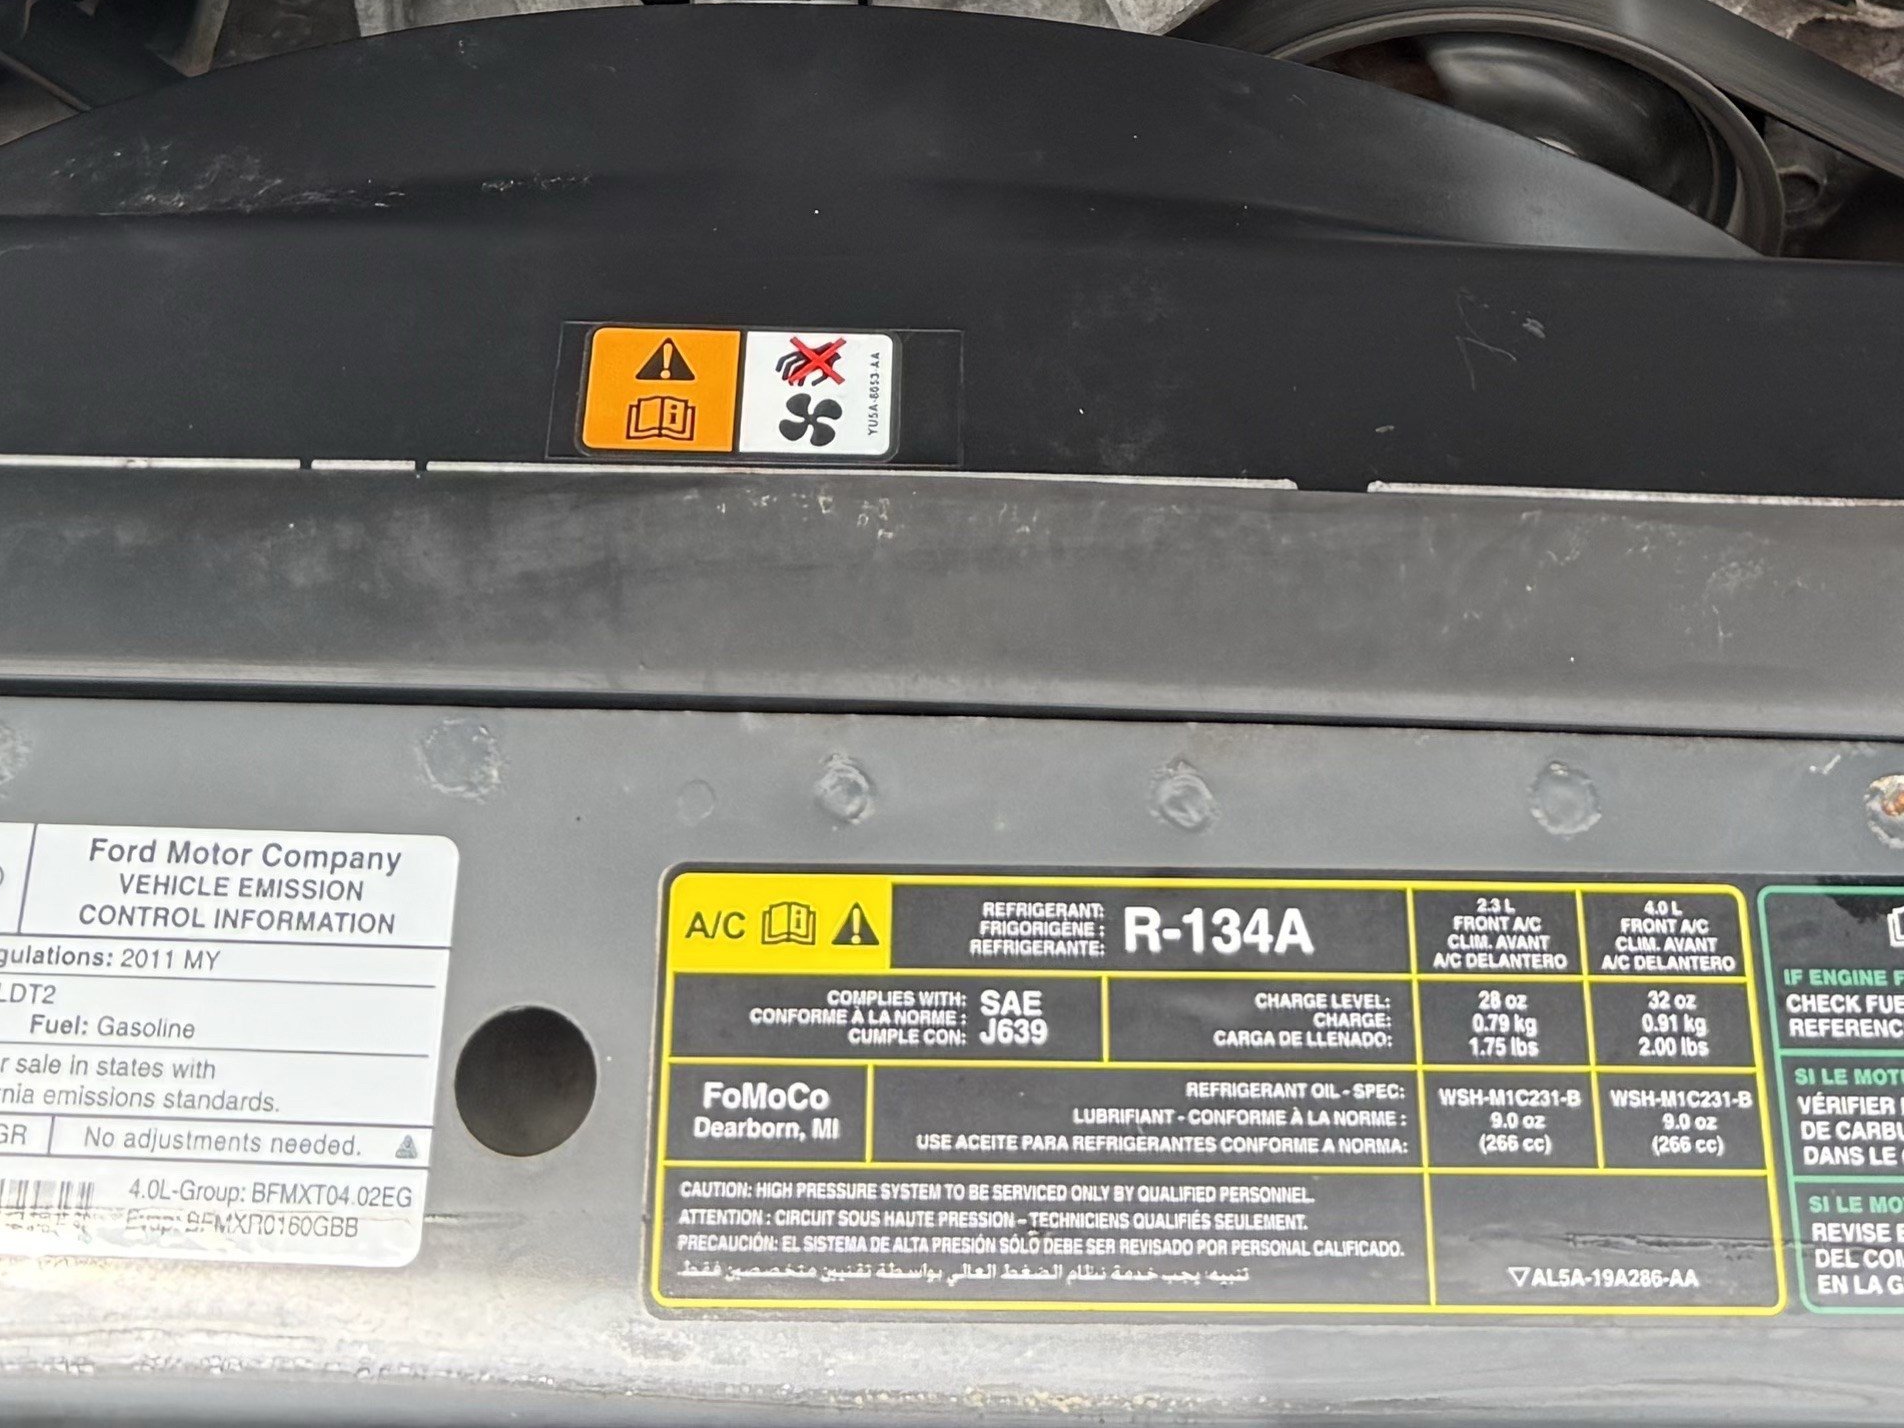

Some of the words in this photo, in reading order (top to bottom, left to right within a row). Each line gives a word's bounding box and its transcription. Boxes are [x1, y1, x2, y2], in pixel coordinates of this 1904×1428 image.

[88, 837, 157, 863] Ford
[166, 839, 253, 867] Motor
[261, 842, 402, 876] Company
[119, 872, 230, 897] VEHICLE
[237, 876, 364, 901] EMISSION
[981, 901, 1104, 919] REFRIGERANT:
[1476, 897, 1501, 914] 2.3
[1503, 897, 1516, 914] L
[1643, 899, 1669, 916] 4.0
[1670, 900, 1683, 916] L
[78, 903, 205, 928] CONTROL
[213, 907, 395, 934] INFORMATION
[684, 910, 745, 939] A/C
[1452, 915, 1510, 932] FRONT
[1511, 915, 1542, 932] A/C
[1124, 906, 1315, 955] R-134A
[968, 938, 1105, 957] REFRIGERANTE:
[1446, 933, 1493, 950] CLIM.
[1494, 934, 1550, 951] AVANT
[119, 947, 173, 969] 2011
[183, 948, 221, 971] MY
[1432, 951, 1462, 969] A/C
[1464, 952, 1568, 970] DELANTERO
[1783, 968, 1803, 985] IF
[1808, 968, 1888, 986] ENGINE
[826, 989, 915, 1007] COMPLIES
[917, 990, 966, 1007] WITH:
[979, 988, 1042, 1016] SAE
[1254, 991, 1328, 1009] CHARGE
[1330, 993, 1390, 1010] LEVEL:
[1477, 989, 1502, 1010] 28
[1504, 993, 1528, 1011] oz
[1647, 989, 1671, 1010] 32
[1673, 993, 1697, 1010] oz
[29, 1013, 88, 1035] Fuel:
[96, 1014, 195, 1039] Gasoline
[978, 1017, 1048, 1045] J639
[1312, 1011, 1392, 1029] CHARGE:
[1471, 1012, 1510, 1033] 0.79
[1513, 1012, 1538, 1035] kg
[1641, 1012, 1678, 1033] 0.91
[1683, 1013, 1709, 1036] kg
[847, 1027, 920, 1045] CUMPLE
[922, 1027, 966, 1046] CON:
[1468, 1035, 1507, 1057] 1.75
[1509, 1035, 1539, 1057] lbs
[1637, 1036, 1677, 1057] 2.00
[1680, 1035, 1710, 1057] lbs
[14, 1052, 62, 1075] sale
[68, 1053, 88, 1076] in
[95, 1056, 164, 1078] states
[171, 1058, 216, 1080] with
[42, 1084, 155, 1108] emissions
[162, 1088, 279, 1112] standards.
[702, 1081, 830, 1111] FoMoCo
[1437, 1087, 1582, 1108] WSH-M1C231-B
[1609, 1088, 1753, 1108] WSH-M1C231-B
[692, 1115, 806, 1142] Dearborn,
[810, 1117, 840, 1139] MI
[1489, 1110, 1519, 1129] 9.0
[1521, 1114, 1546, 1130] oz
[83, 1125, 115, 1148] No
[122, 1127, 261, 1153] adjustments
[269, 1133, 361, 1156] needed.
[1478, 1132, 1519, 1155] (266
[1521, 1133, 1552, 1155] cc)
[128, 1177, 246, 1206] 4.0L-Group:
[250, 1181, 412, 1208] BFMXT04.02EG
[679, 1180, 752, 1198] CAUTION:
[754, 1181, 793, 1199] HIGH
[795, 1181, 878, 1200] PRESSURE
[878, 1182, 942, 1200] SYSTEM
[942, 1182, 965, 1201] TO
[967, 1183, 989, 1201] BE
[991, 1183, 1067, 1202] SERVICED
[1070, 1184, 1110, 1202] ONLY
[1112, 1184, 1134, 1202] BY
[1136, 1184, 1217, 1203] QUALIFIED
[1218, 1185, 1315, 1204] PERSONNEL.
[1808, 1195, 1830, 1213] SI
[1835, 1195, 1863, 1214] LE
[1529, 1267, 1700, 1288] AL5A-19A286-AA
